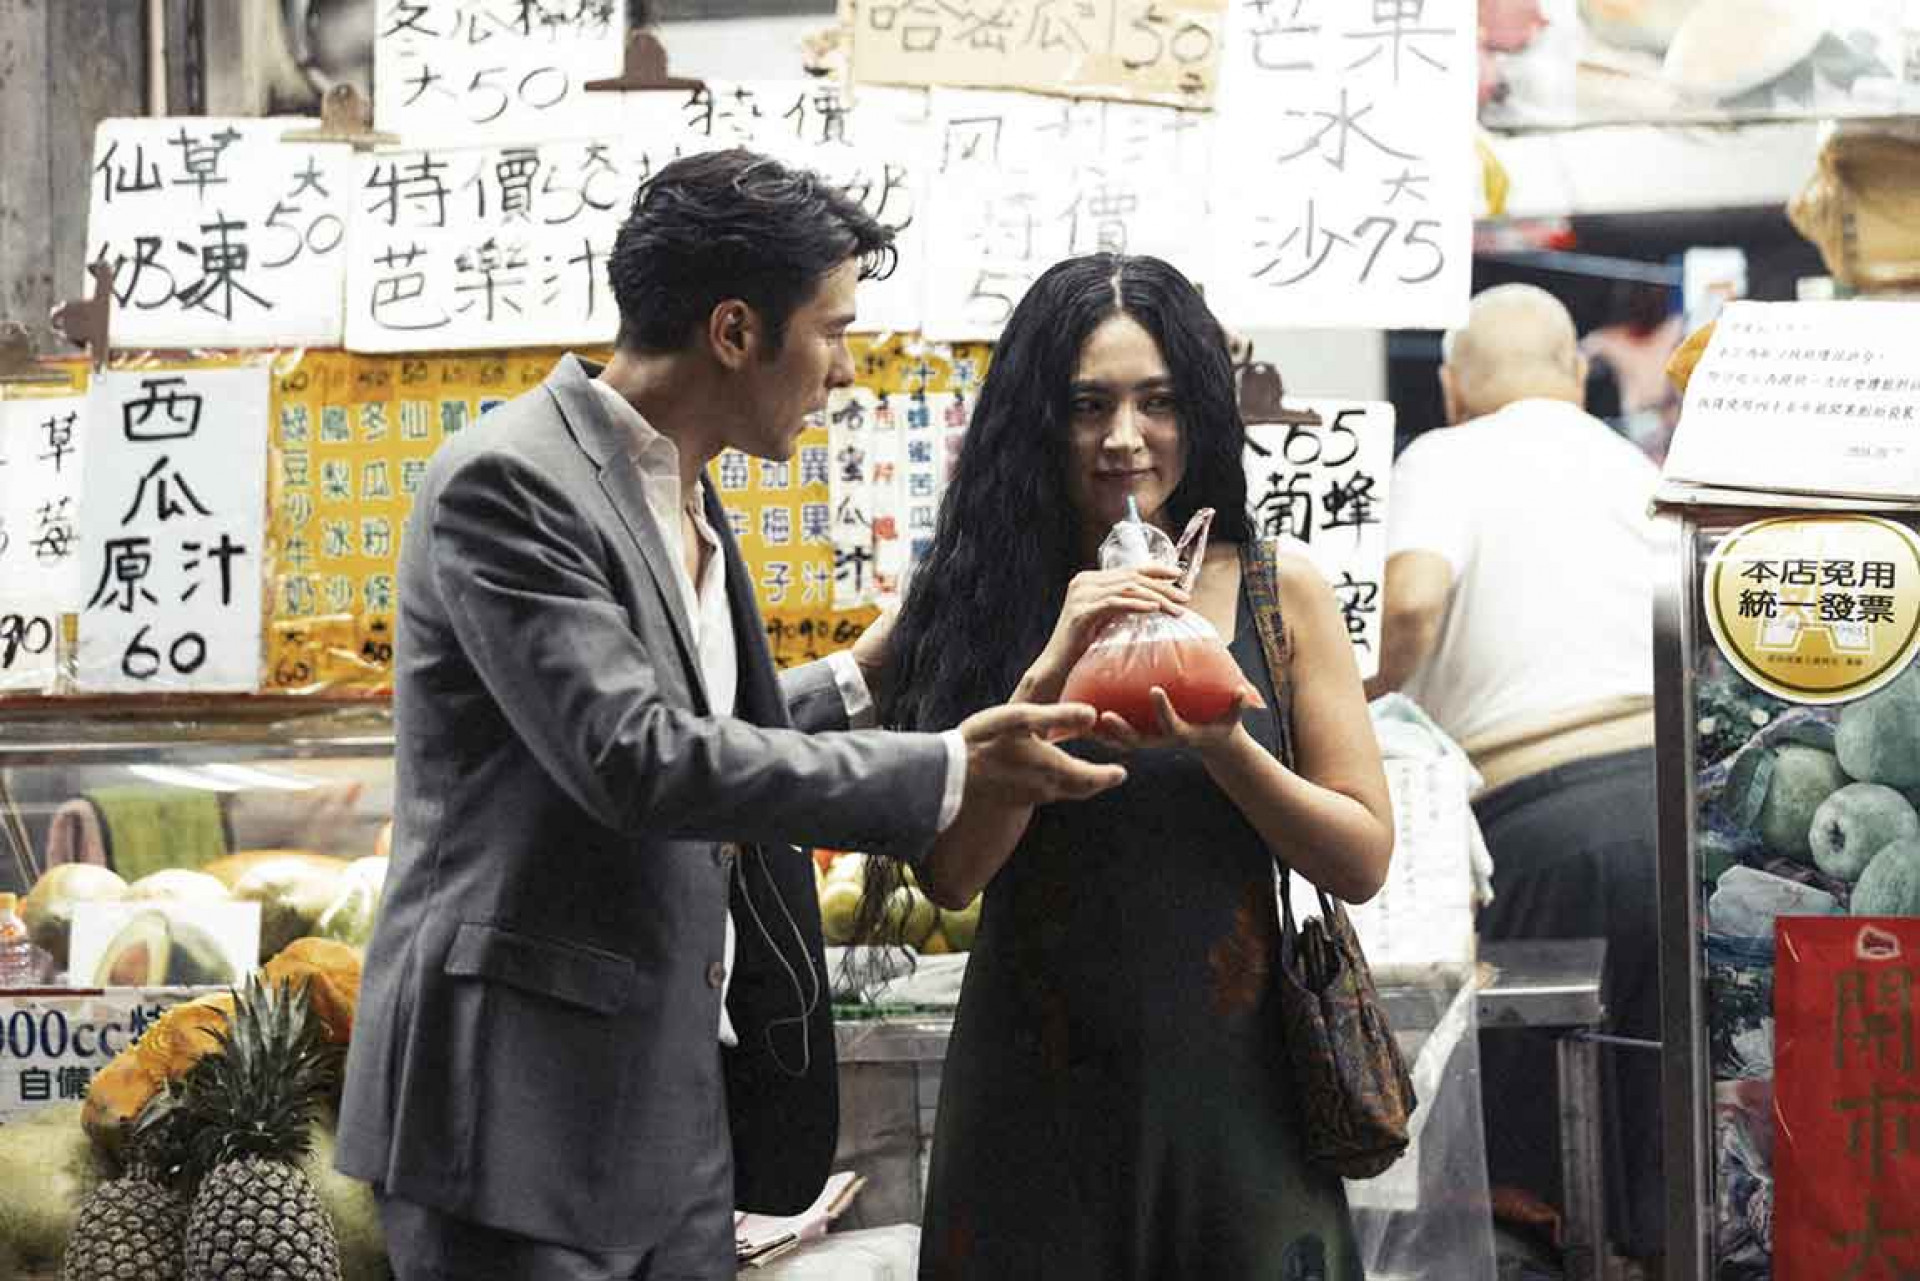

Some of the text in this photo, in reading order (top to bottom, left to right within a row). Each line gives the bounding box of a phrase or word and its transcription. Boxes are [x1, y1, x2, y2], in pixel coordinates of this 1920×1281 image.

[867, 0, 1115, 53] 哈密瓜
[1122, 5, 1213, 70] 50
[1278, 90, 1424, 171] 水
[97, 128, 242, 204] 仙草
[293, 157, 330, 198] 大
[1383, 169, 1430, 205] 大
[262, 200, 344, 268] 50
[370, 237, 612, 330] 芭樂汁
[1741, 560, 1896, 589] 本店免用
[1738, 588, 1896, 623] 統一發票
[121, 624, 207, 679] 60
[20, 1066, 100, 1100] 自備
